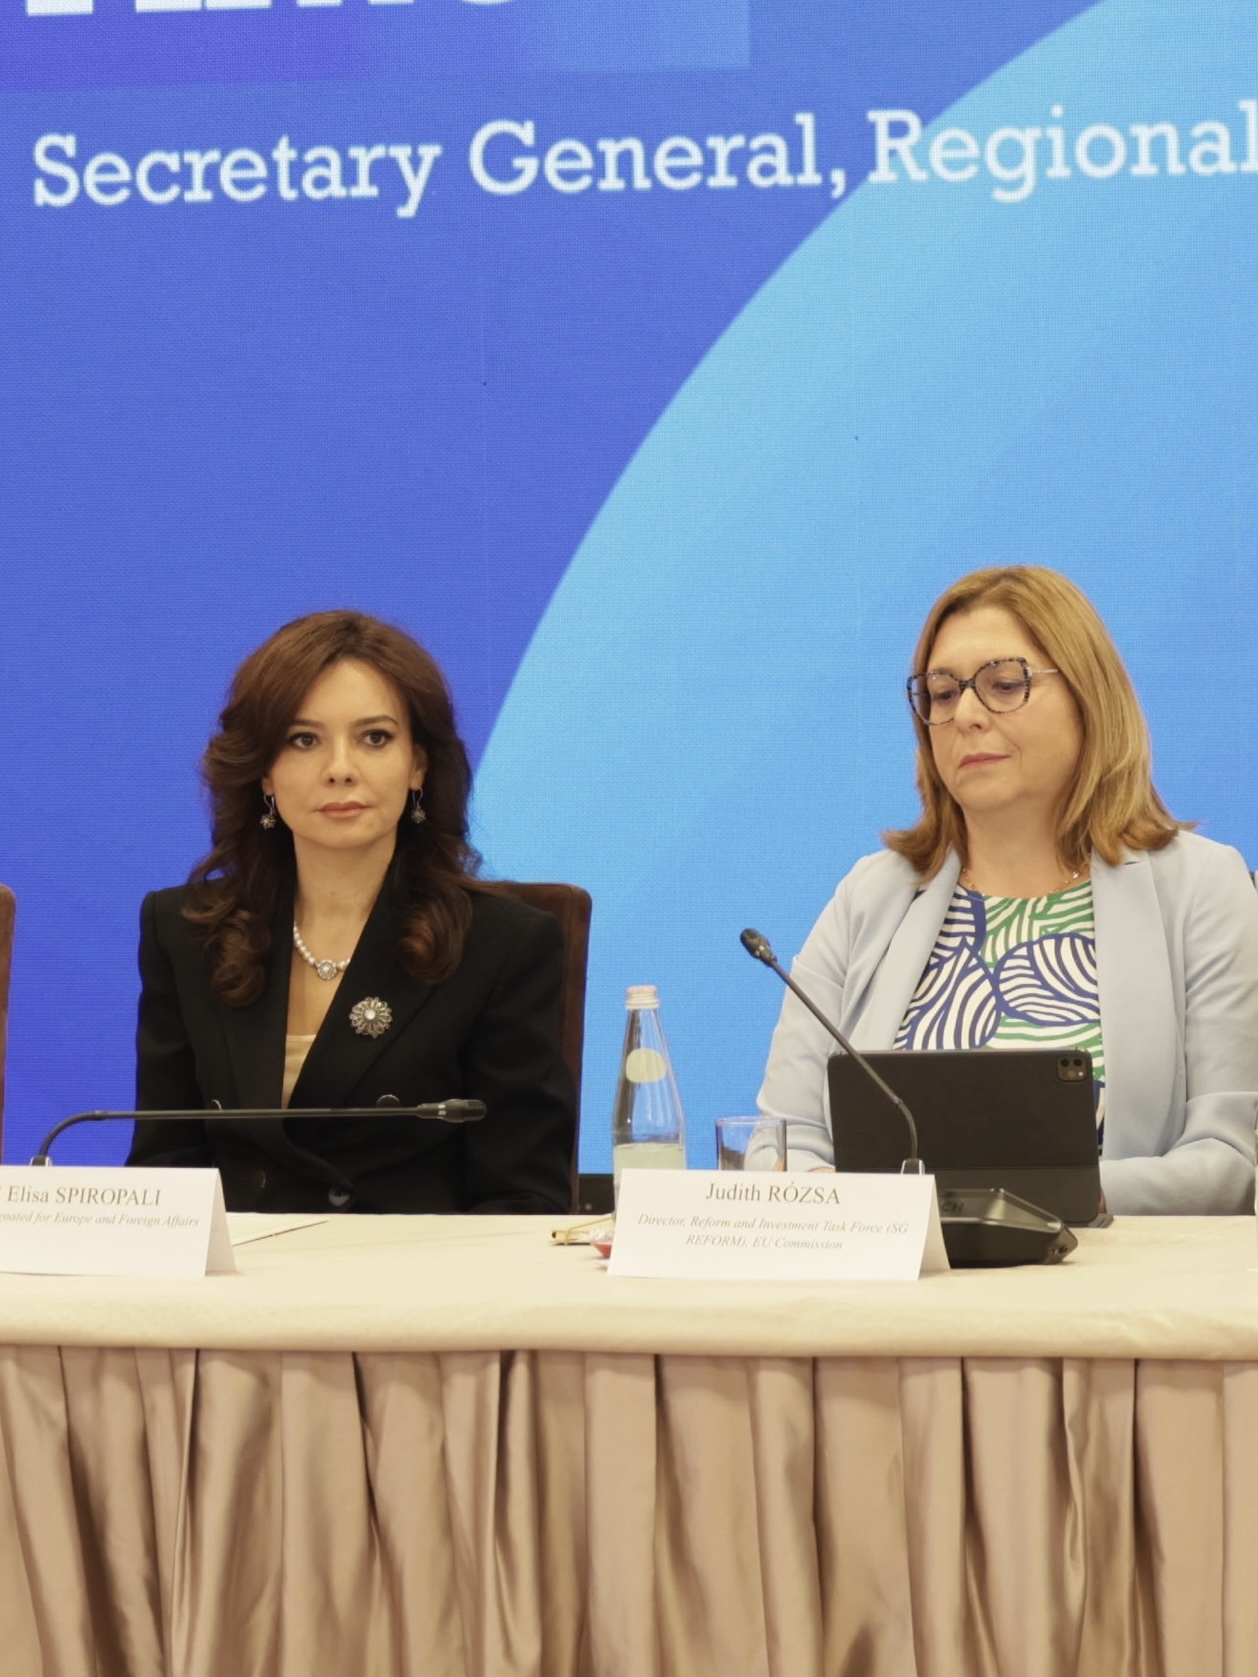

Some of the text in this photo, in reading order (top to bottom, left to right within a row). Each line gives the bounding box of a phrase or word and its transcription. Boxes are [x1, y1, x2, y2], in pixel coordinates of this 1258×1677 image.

[34, 134, 442, 218] Secretary
[470, 113, 846, 197] General,
[7, 1185, 162, 1207] Elisa SPIROPALI
[705, 1180, 841, 1205] Judith RÓZSA
[32, 1211, 50, 1226] for
[54, 1211, 93, 1227] Europe
[94, 1213, 116, 1225] and
[118, 1212, 160, 1228] Foreign
[163, 1214, 199, 1228] Affairs
[690, 1215, 731, 1230] Reform
[734, 1217, 757, 1229] and
[758, 1218, 820, 1231] Investment
[823, 1220, 848, 1232] Task
[851, 1221, 884, 1233] Force
[753, 1235, 774, 1248] EU
[774, 1237, 844, 1250] Commission
